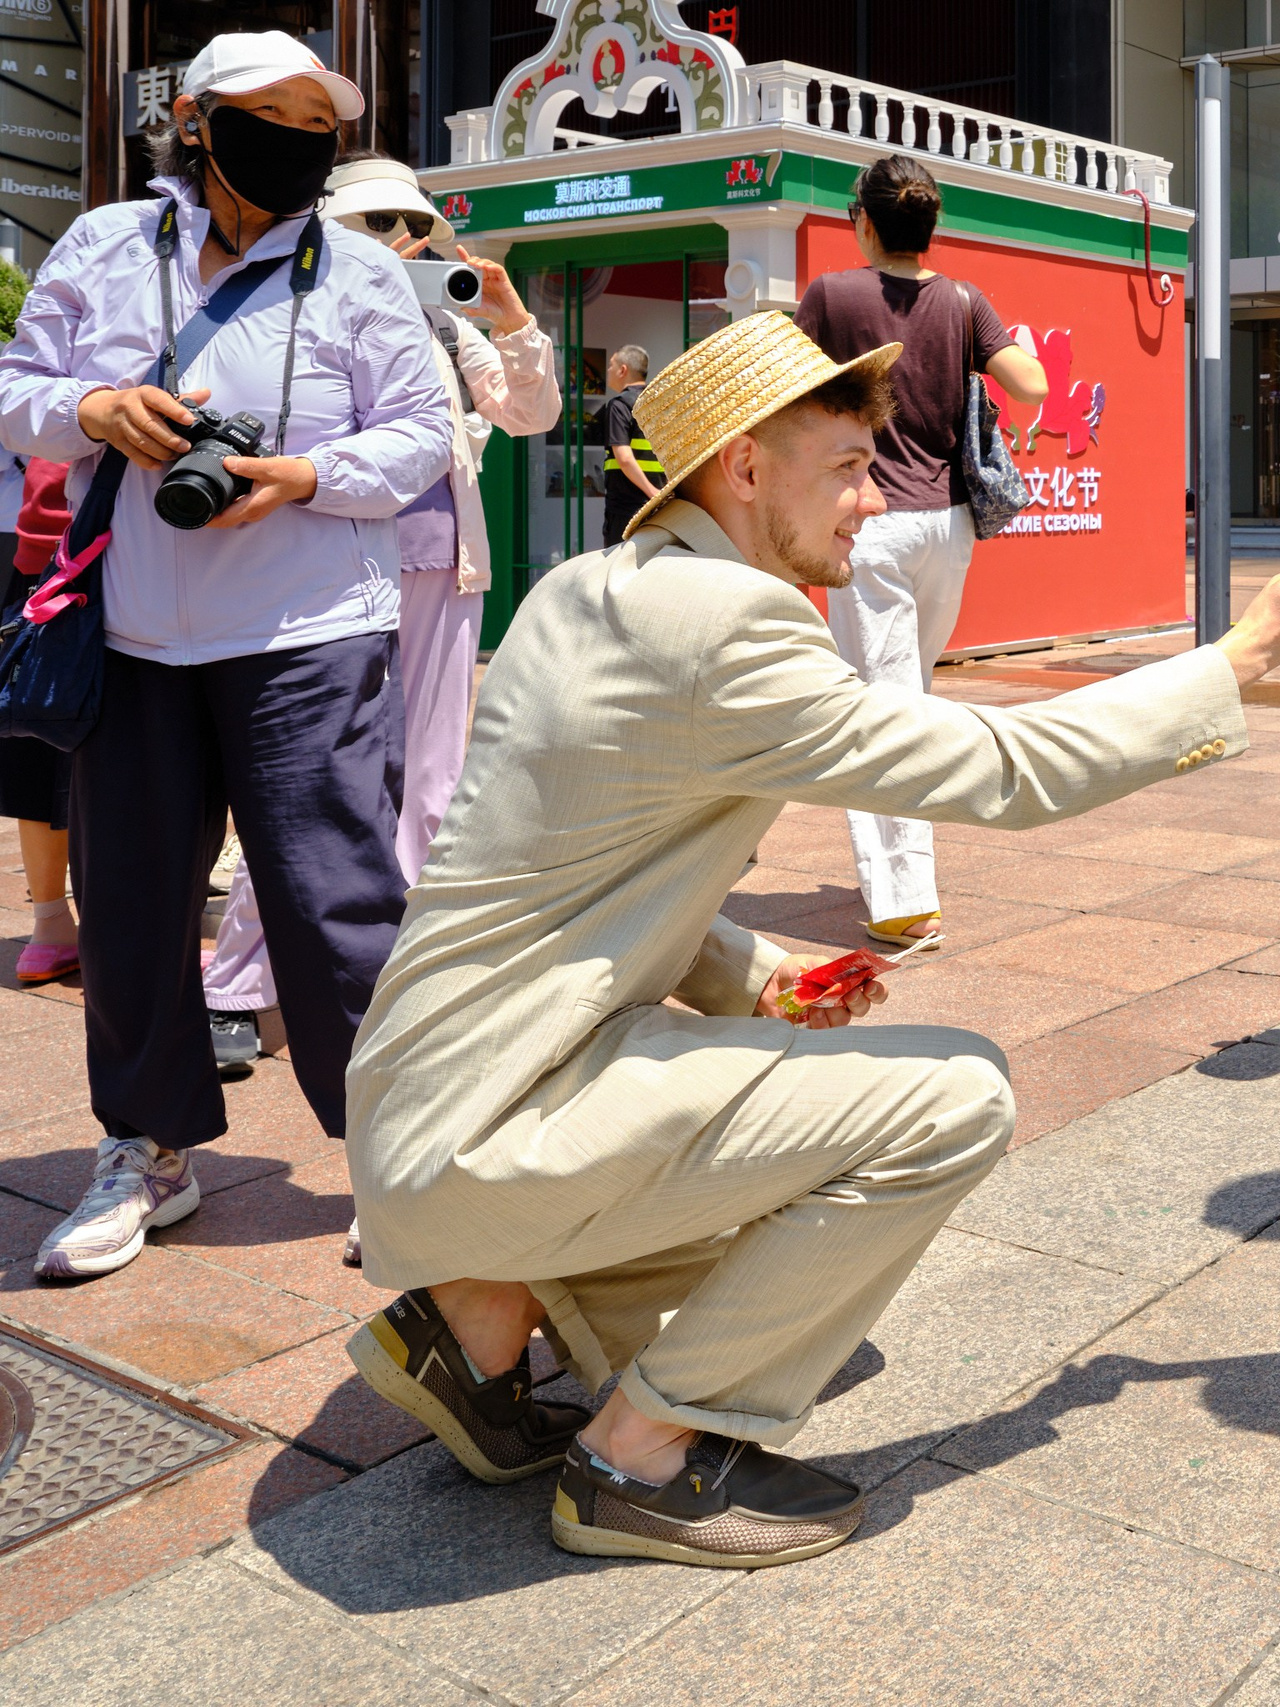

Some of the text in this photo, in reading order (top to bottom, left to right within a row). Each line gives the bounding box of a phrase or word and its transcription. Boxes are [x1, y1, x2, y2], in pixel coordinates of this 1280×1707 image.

[136, 65, 188, 128] 東
[0, 177, 82, 203] iberaide
[555, 175, 631, 205] 莫斯科交通
[161, 212, 173, 233] Nikon
[524, 196, 664, 223] МОСКОВСКИЙ ТРАНСПОРТ
[301, 247, 315, 270] Nikon
[228, 428, 251, 444] Nikon
[1017, 466, 1102, 508] 文化节
[1043, 513, 1102, 532] СЕЗОНЫ
